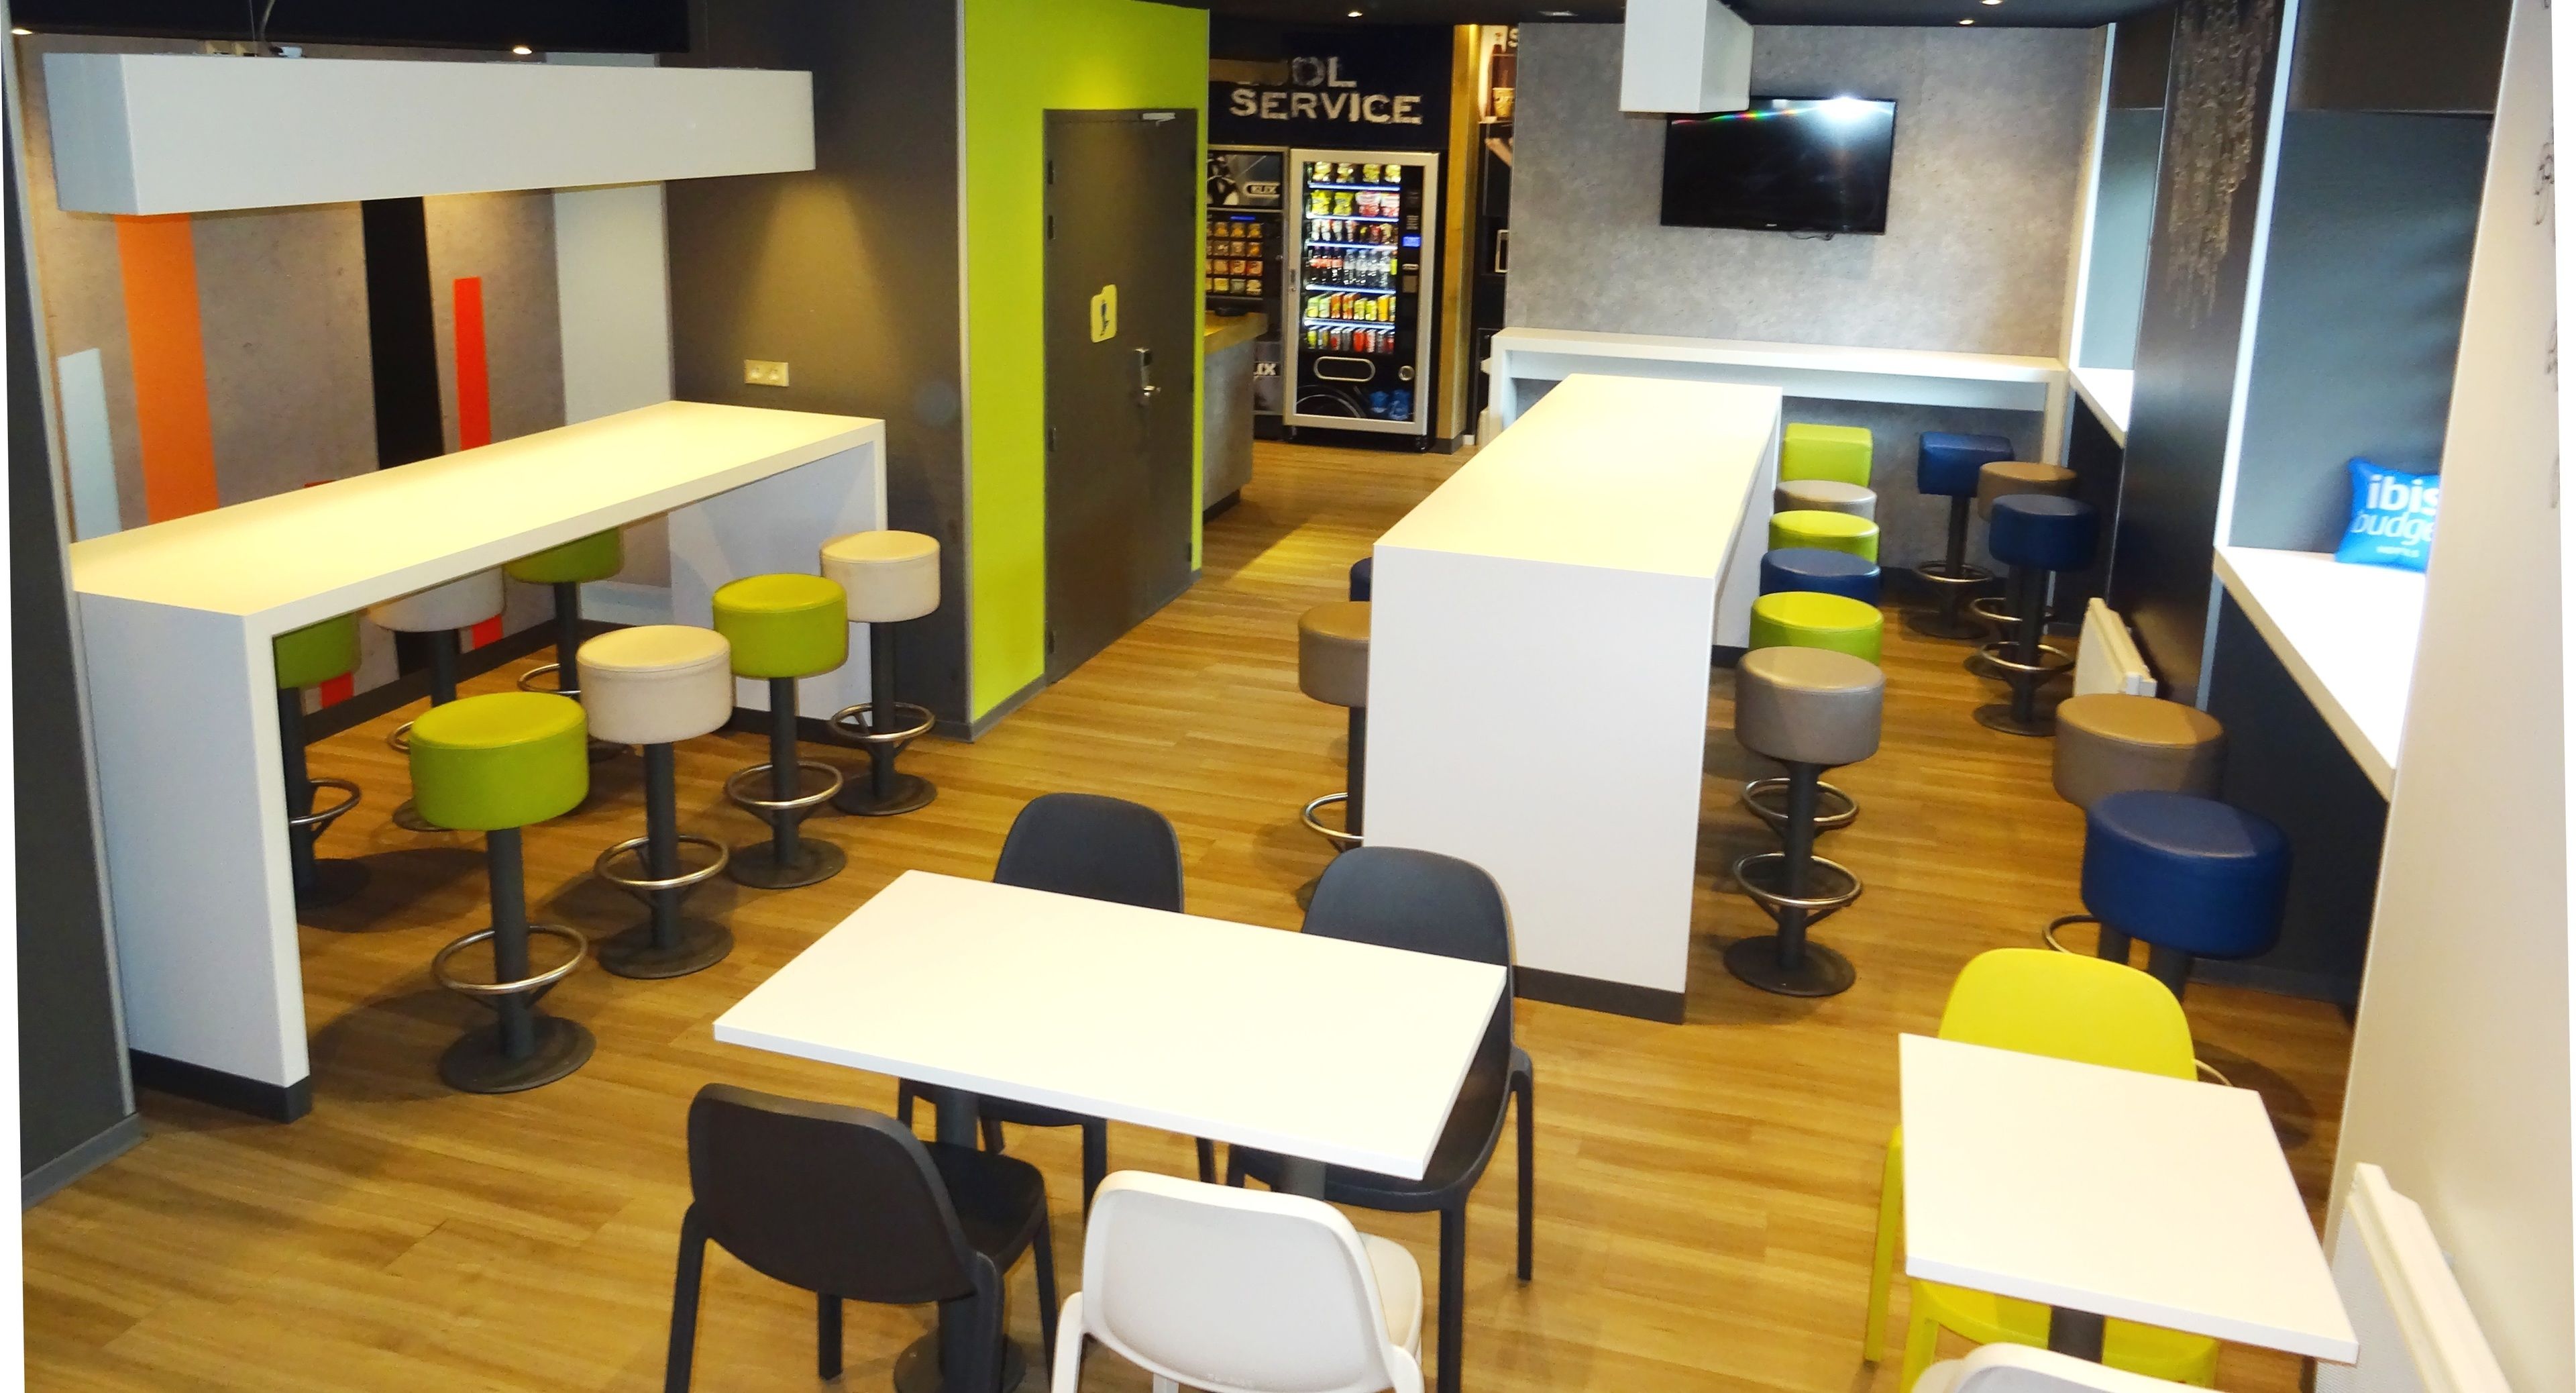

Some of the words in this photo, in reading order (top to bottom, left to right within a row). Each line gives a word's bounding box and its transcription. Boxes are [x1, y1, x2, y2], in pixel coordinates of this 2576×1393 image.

[1229, 89, 1422, 125] SERVICE
[2366, 474, 2439, 515] ibis
[2351, 511, 2434, 545] budge
